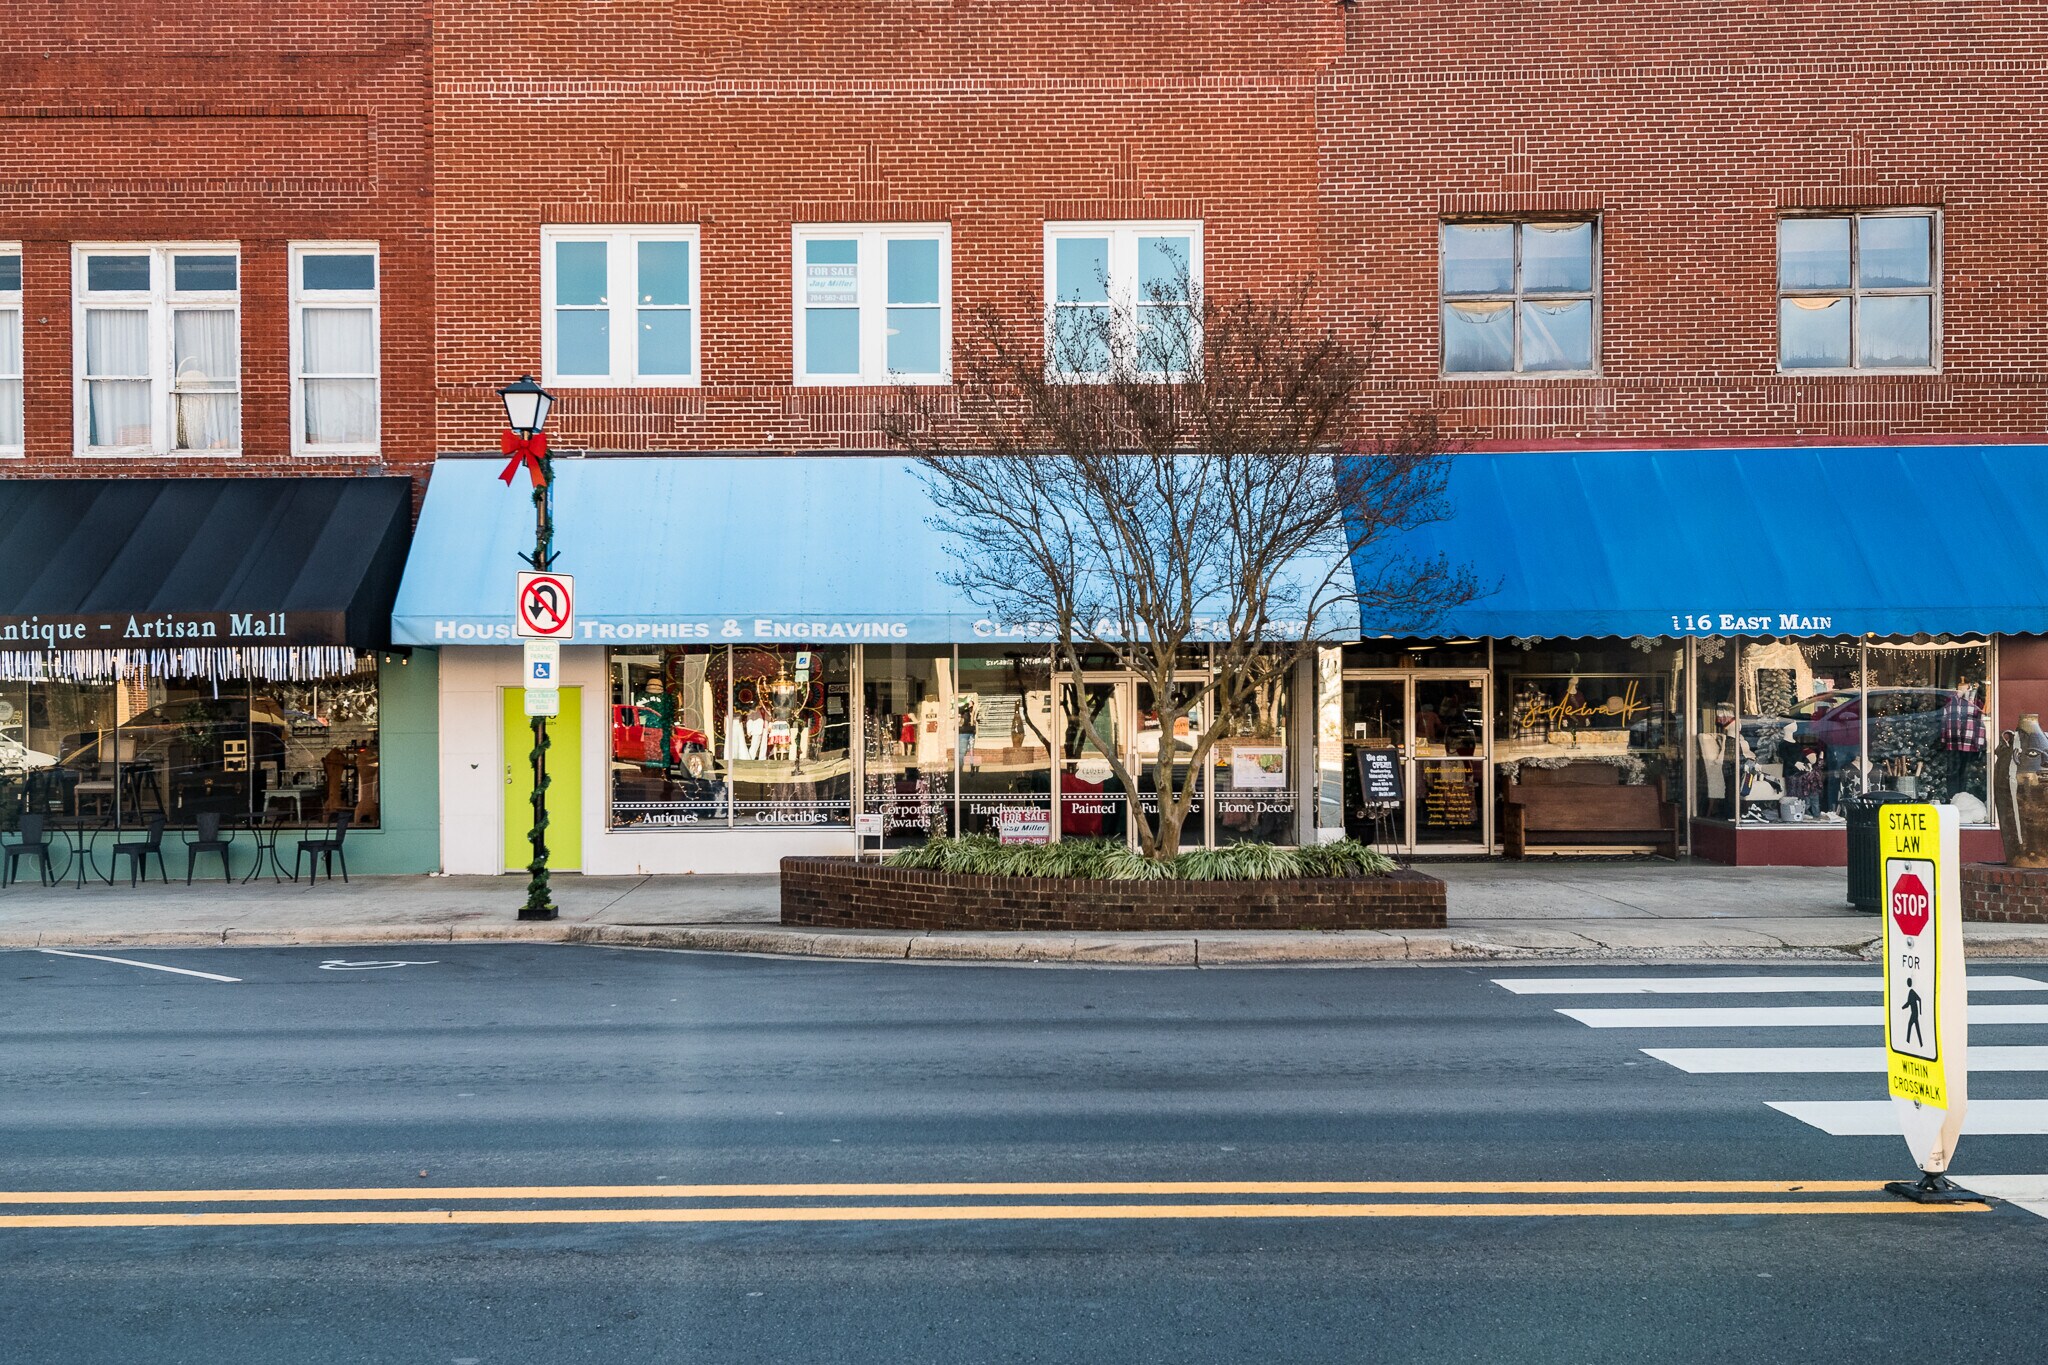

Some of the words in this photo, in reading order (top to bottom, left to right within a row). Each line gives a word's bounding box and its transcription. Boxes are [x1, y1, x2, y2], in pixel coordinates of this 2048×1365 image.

[809, 267, 828, 276] FOR
[831, 267, 854, 276] SALE
[809, 280, 827, 288] Jay
[578, 620, 710, 639] TROPHIES
[720, 618, 742, 638] &
[754, 619, 908, 638] ENGRAVING
[1671, 614, 1713, 631] 116
[1719, 614, 1771, 630] EAST
[1778, 614, 1832, 630] MAIN
[0, 616, 86, 649] ntique
[123, 614, 217, 638] Artisan
[229, 612, 287, 637] Mall
[1522, 680, 1651, 729] sidewalk
[878, 803, 940, 817] Corporate
[970, 803, 1041, 815] Handwoven
[1071, 802, 1116, 814] Painted
[1218, 801, 1254, 813] Home
[1256, 801, 1292, 813] Decor
[642, 812, 698, 826] Antiques
[755, 811, 828, 823] Collectibles
[889, 817, 931, 828] Awards
[1024, 813, 1047, 821] SALE
[1889, 813, 1927, 831] STATE
[1895, 836, 1920, 853] LAW
[1893, 893, 1927, 917] STOP
[1902, 954, 1920, 970] FOR
[1901, 1059, 1928, 1078] WITHIN
[1893, 1075, 1941, 1101] CROSSWALK
